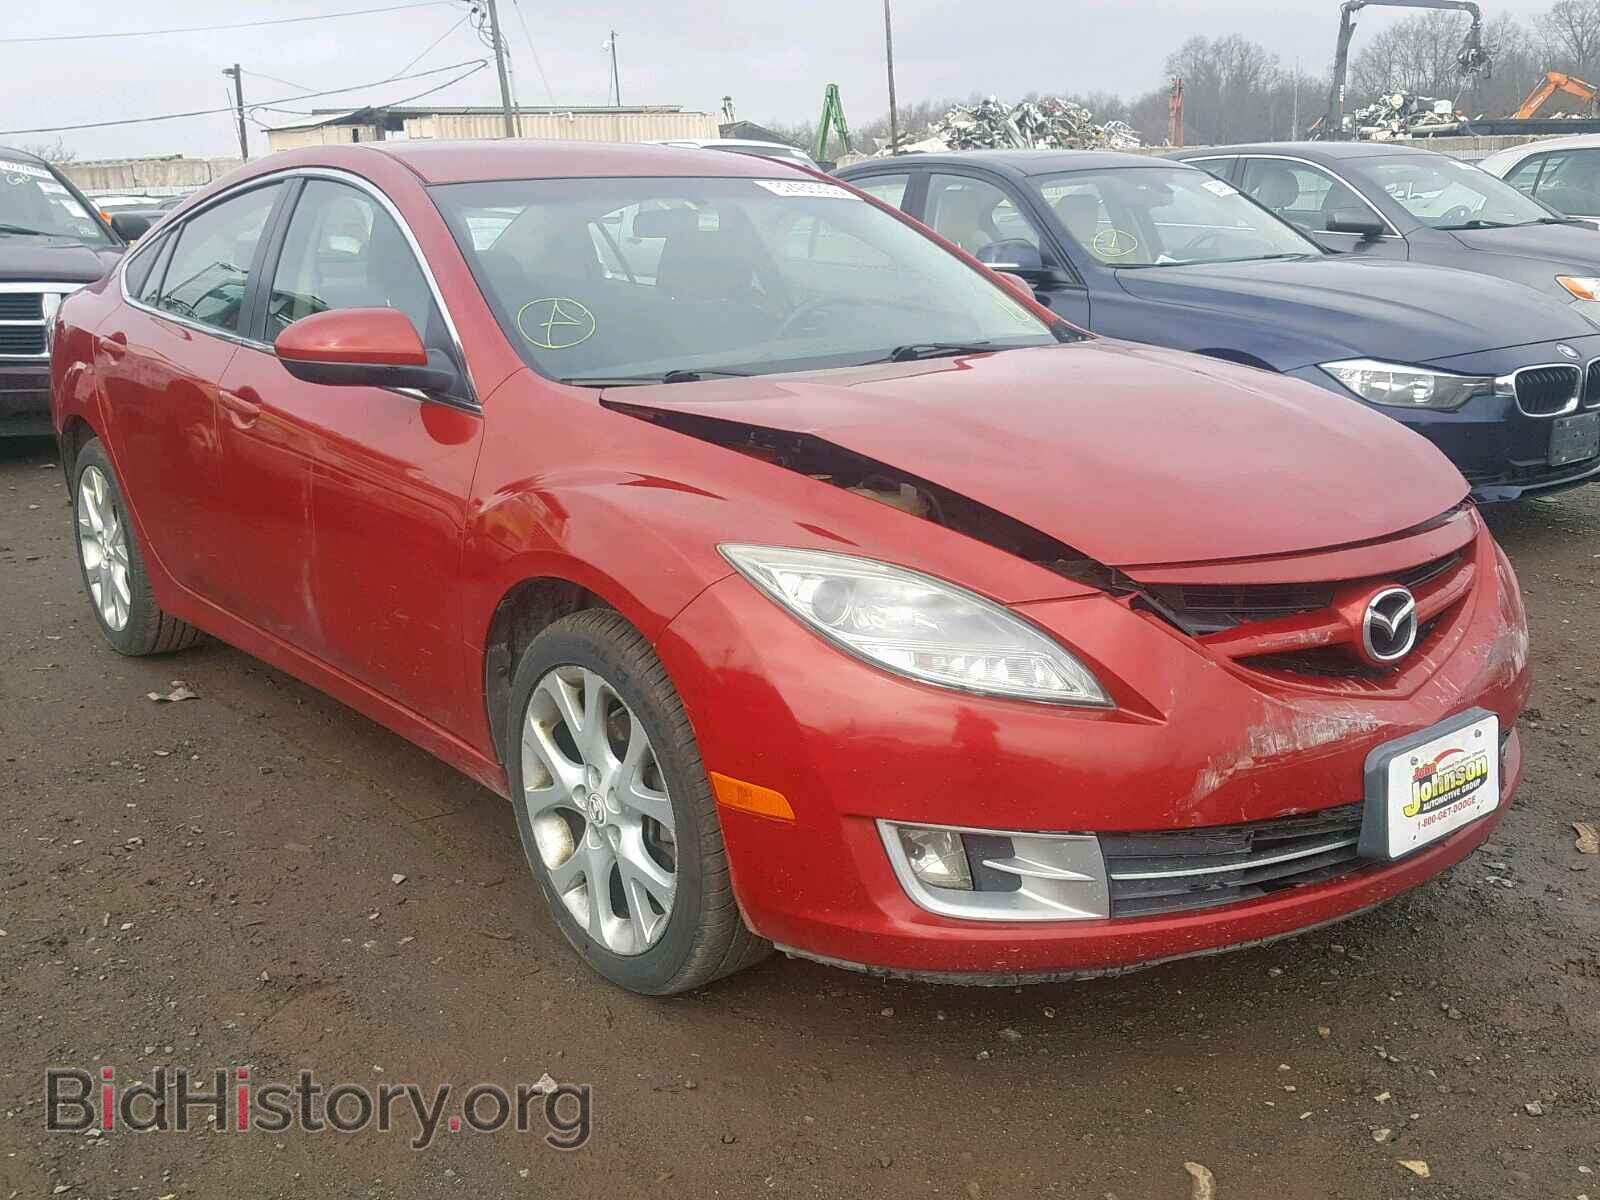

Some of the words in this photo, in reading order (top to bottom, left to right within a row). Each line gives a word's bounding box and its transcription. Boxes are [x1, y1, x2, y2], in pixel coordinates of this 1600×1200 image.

[1403, 755, 1488, 818] Johnson
[1423, 789, 1461, 811] AUTOMOTIVE
[1461, 778, 1481, 794] GROUP
[1417, 794, 1476, 830] 1-800-GET-DODGE
